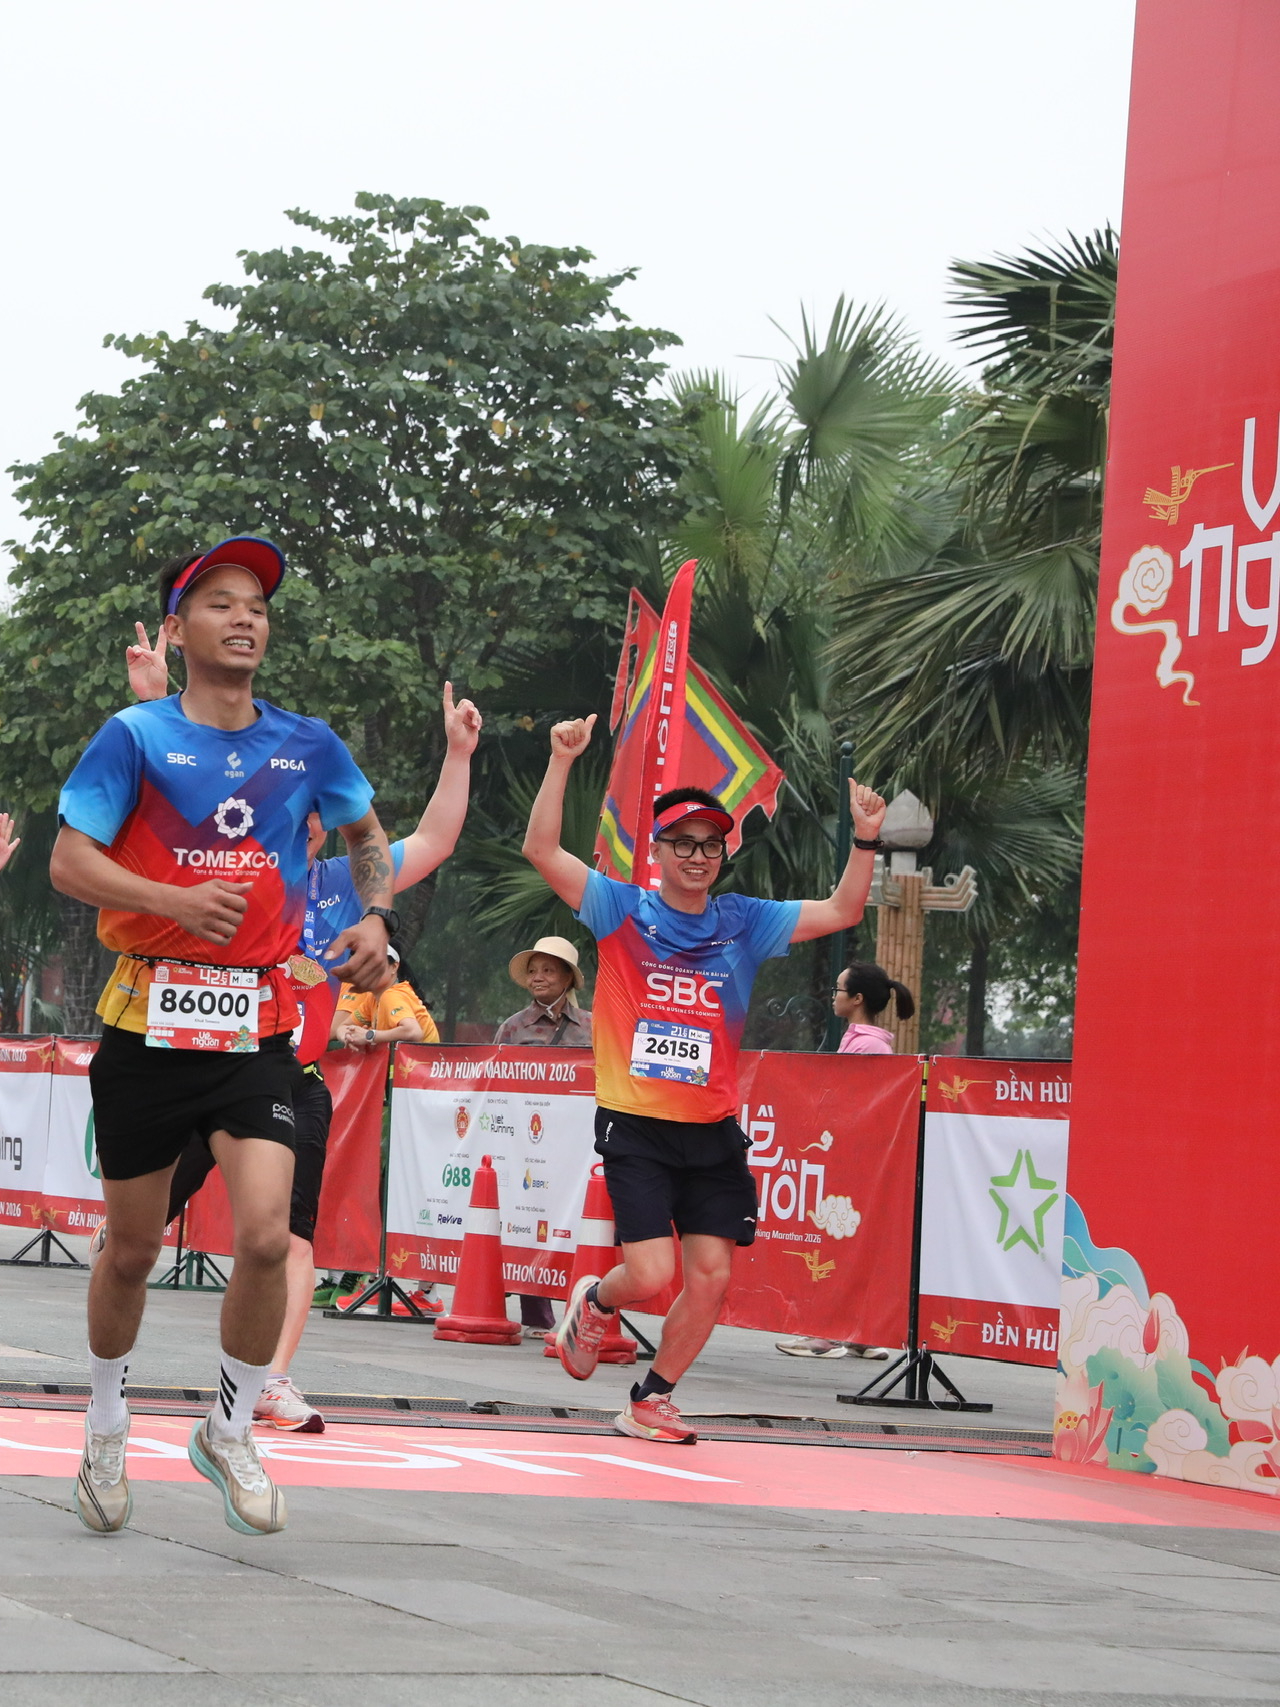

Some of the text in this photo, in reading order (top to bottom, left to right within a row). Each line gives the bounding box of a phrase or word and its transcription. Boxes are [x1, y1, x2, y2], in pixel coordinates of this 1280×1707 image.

[166, 752, 197, 767] SBC
[224, 769, 245, 779] egan
[173, 847, 280, 870] TOMEXCO
[232, 975, 240, 984] M
[646, 972, 724, 1010] SBC
[160, 988, 250, 1018] 86000
[640, 1002, 666, 1011] SUCCESS
[666, 1006, 695, 1015] BUSINESS
[645, 1037, 700, 1061] 26158
[430, 1052, 576, 1082] ĐỀN HÙNG MARATHON 2026
[995, 1068, 1072, 1103] ĐỀN HÙ
[490, 1124, 515, 1137] Running
[5, 1201, 22, 1217] 2026
[67, 1203, 85, 1226] ĐỀN
[437, 1213, 463, 1226] ReVive
[771, 1230, 804, 1242] Marathon
[804, 1233, 821, 1244] 2026
[420, 1244, 567, 1288] ĐỀN HÙ THON 2026
[981, 1311, 1058, 1352] ĐỀN HÙ
